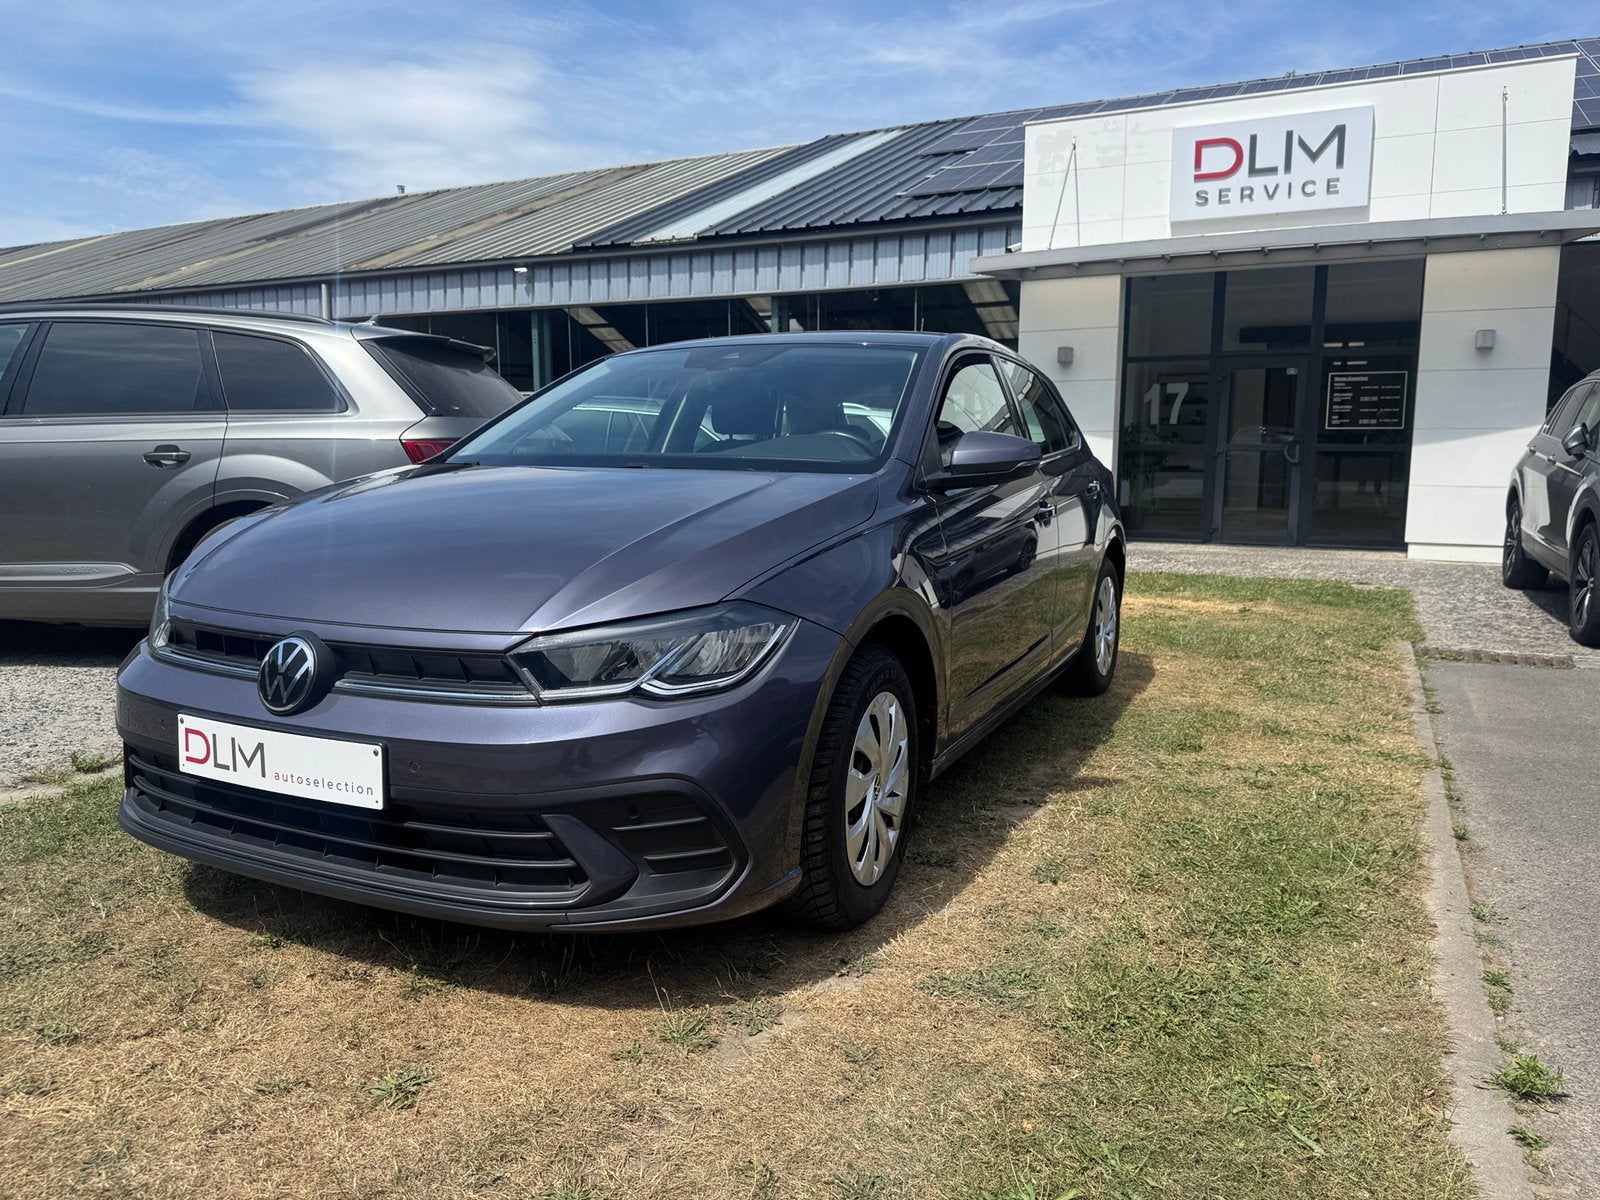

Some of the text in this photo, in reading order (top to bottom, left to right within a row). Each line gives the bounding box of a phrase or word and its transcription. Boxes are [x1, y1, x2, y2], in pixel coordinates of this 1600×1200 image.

[1194, 124, 1346, 182] DLM
[1195, 177, 1340, 207] SERVICE
[1143, 382, 1189, 425] 17
[184, 727, 266, 778] DLM
[273, 771, 374, 796] autoselection
